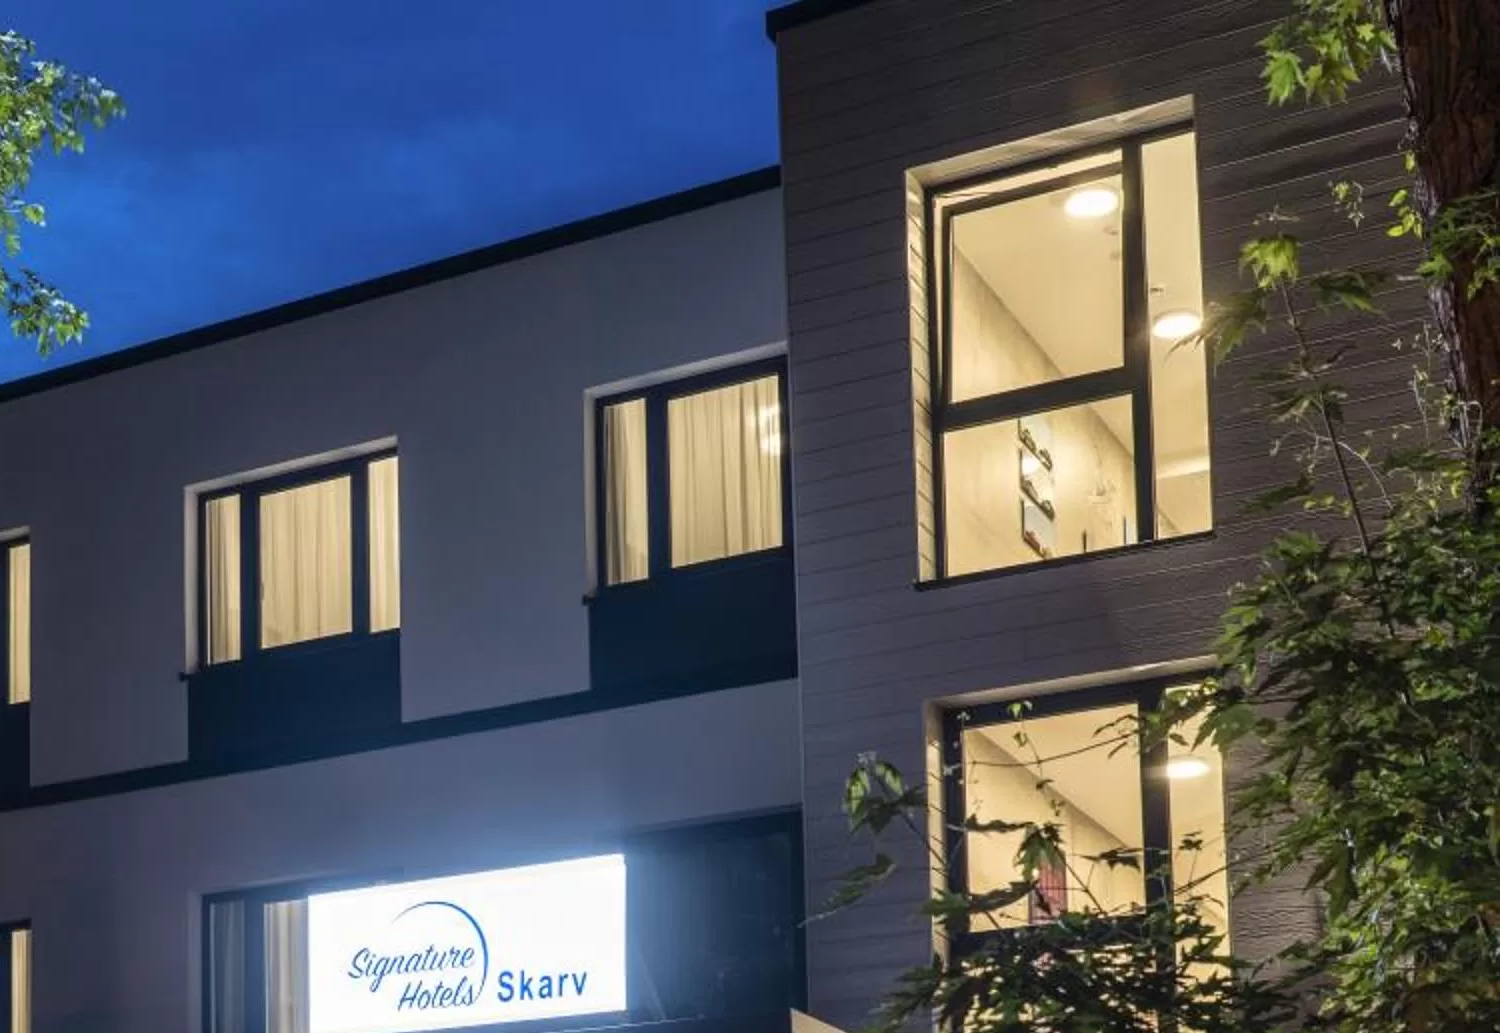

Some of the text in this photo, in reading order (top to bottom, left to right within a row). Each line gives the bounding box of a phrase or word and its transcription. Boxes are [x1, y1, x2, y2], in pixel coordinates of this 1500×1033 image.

[347, 944, 475, 992] Signature
[497, 969, 588, 1003] Skarv
[397, 975, 475, 1012] Hotels
